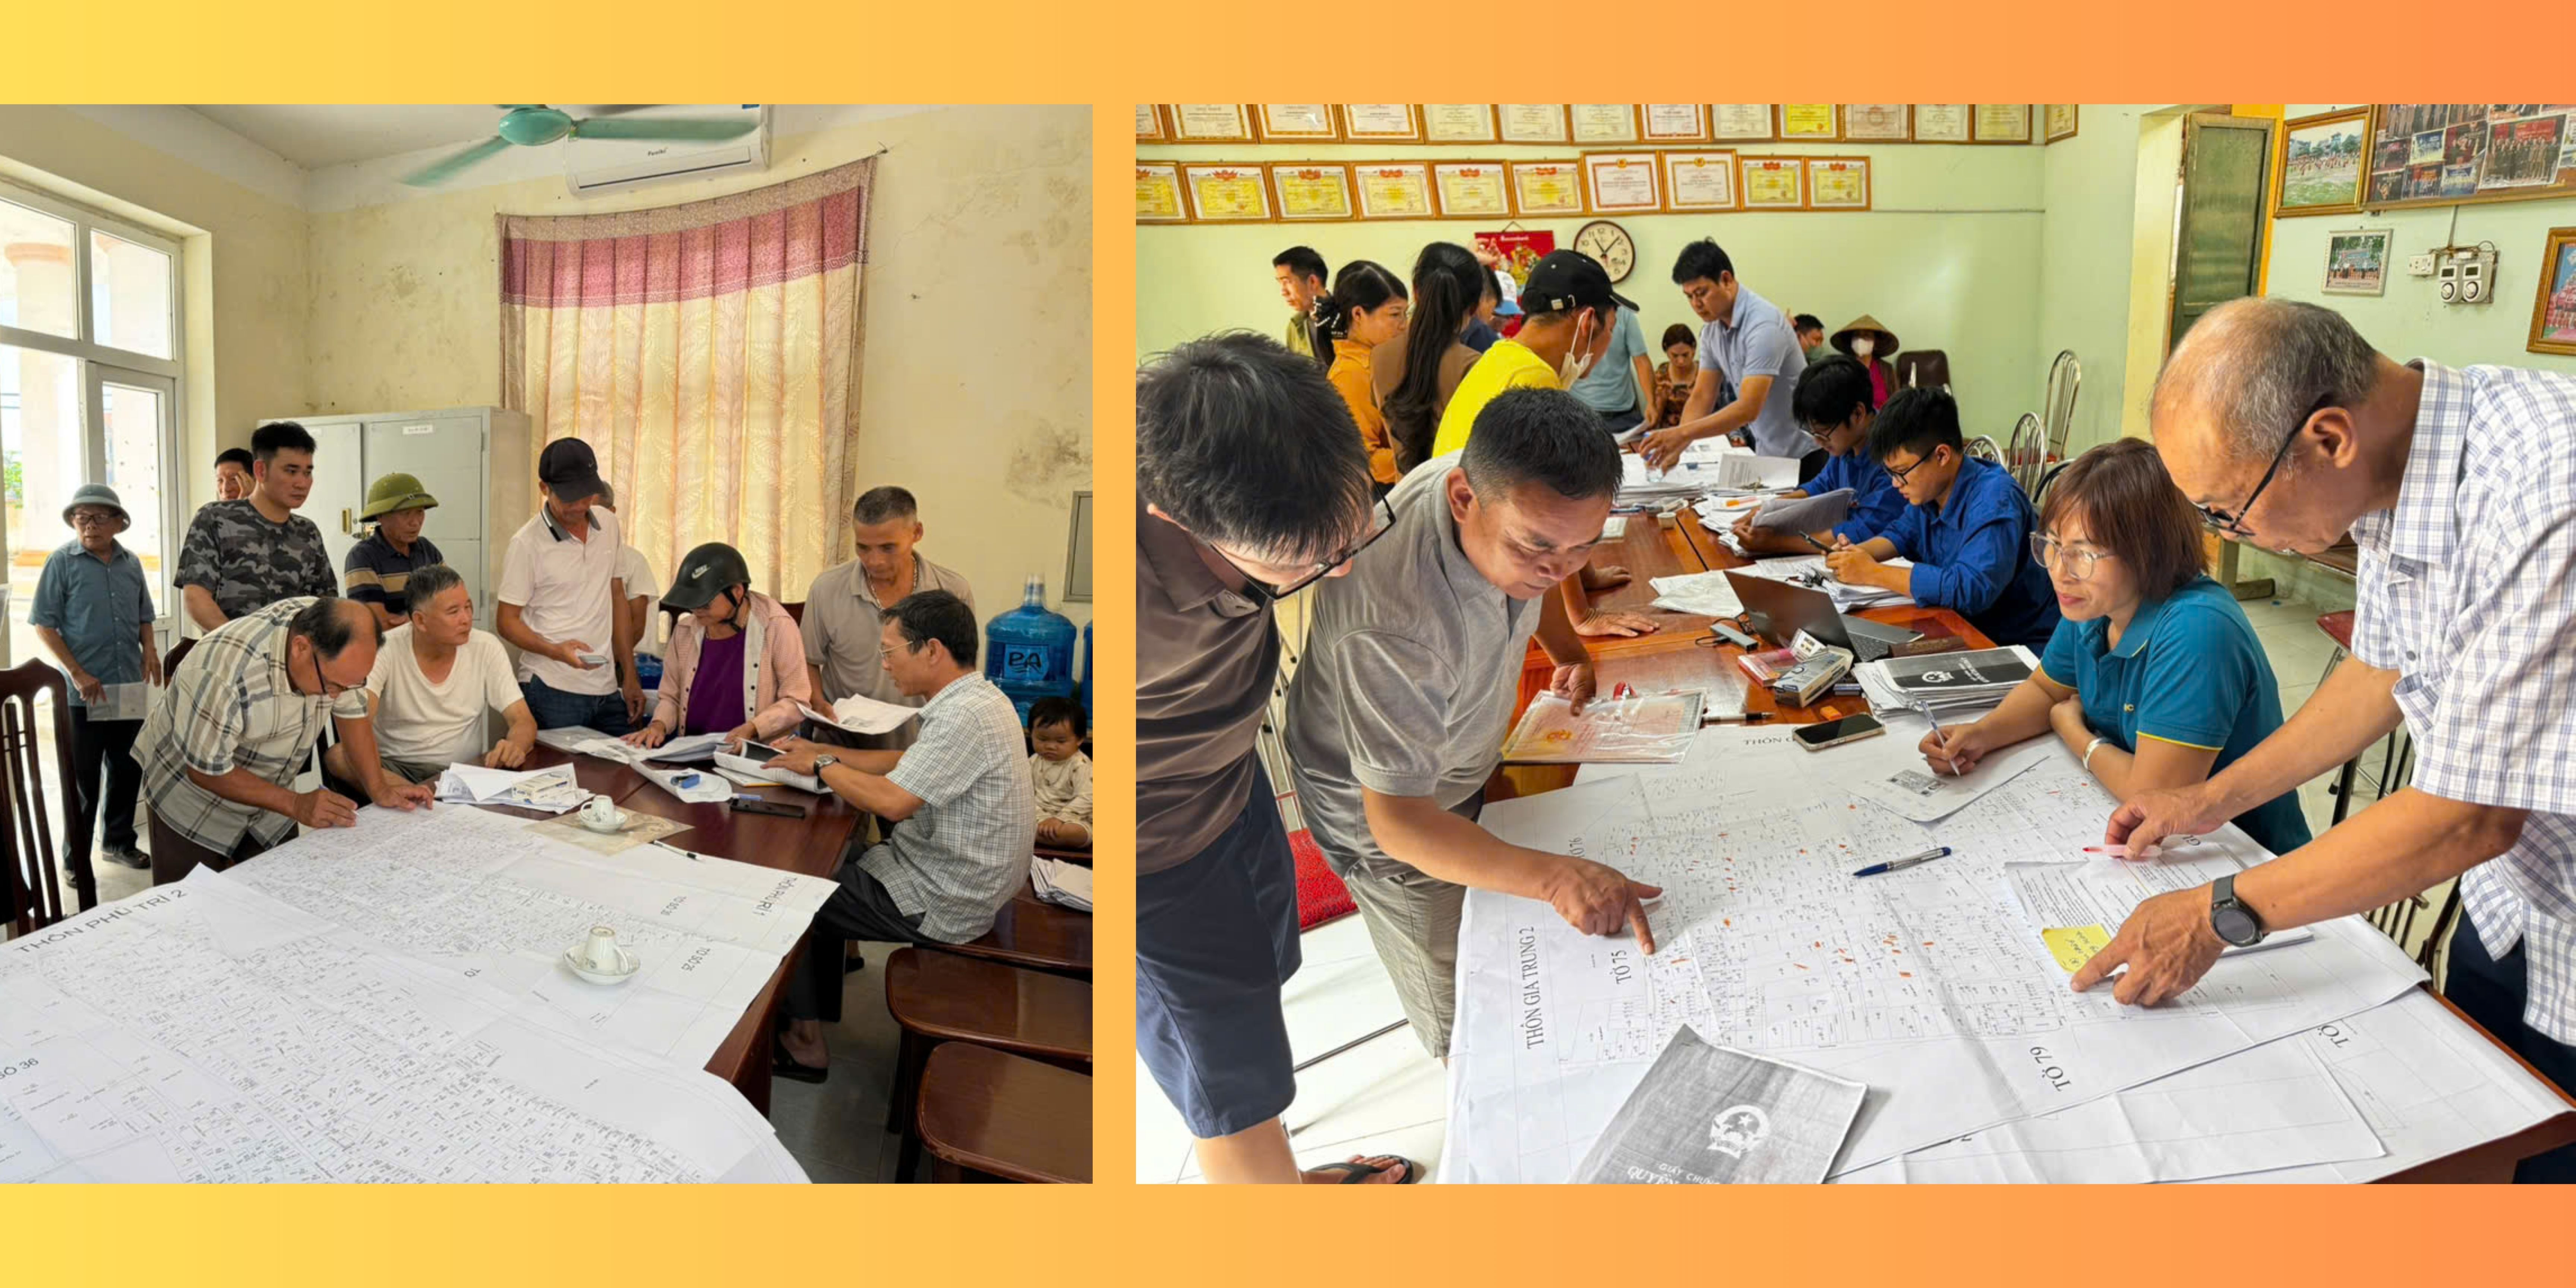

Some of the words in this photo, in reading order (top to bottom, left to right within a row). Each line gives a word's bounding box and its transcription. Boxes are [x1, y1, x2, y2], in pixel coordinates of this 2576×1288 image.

[170, 889, 187, 899] 2
[1519, 935, 1538, 980] TRUNG
[1611, 950, 1627, 963] 75
[1523, 980, 1541, 1006] GIA
[1519, 1007, 1544, 1049] THÔN
[2029, 1046, 2053, 1064] 79
